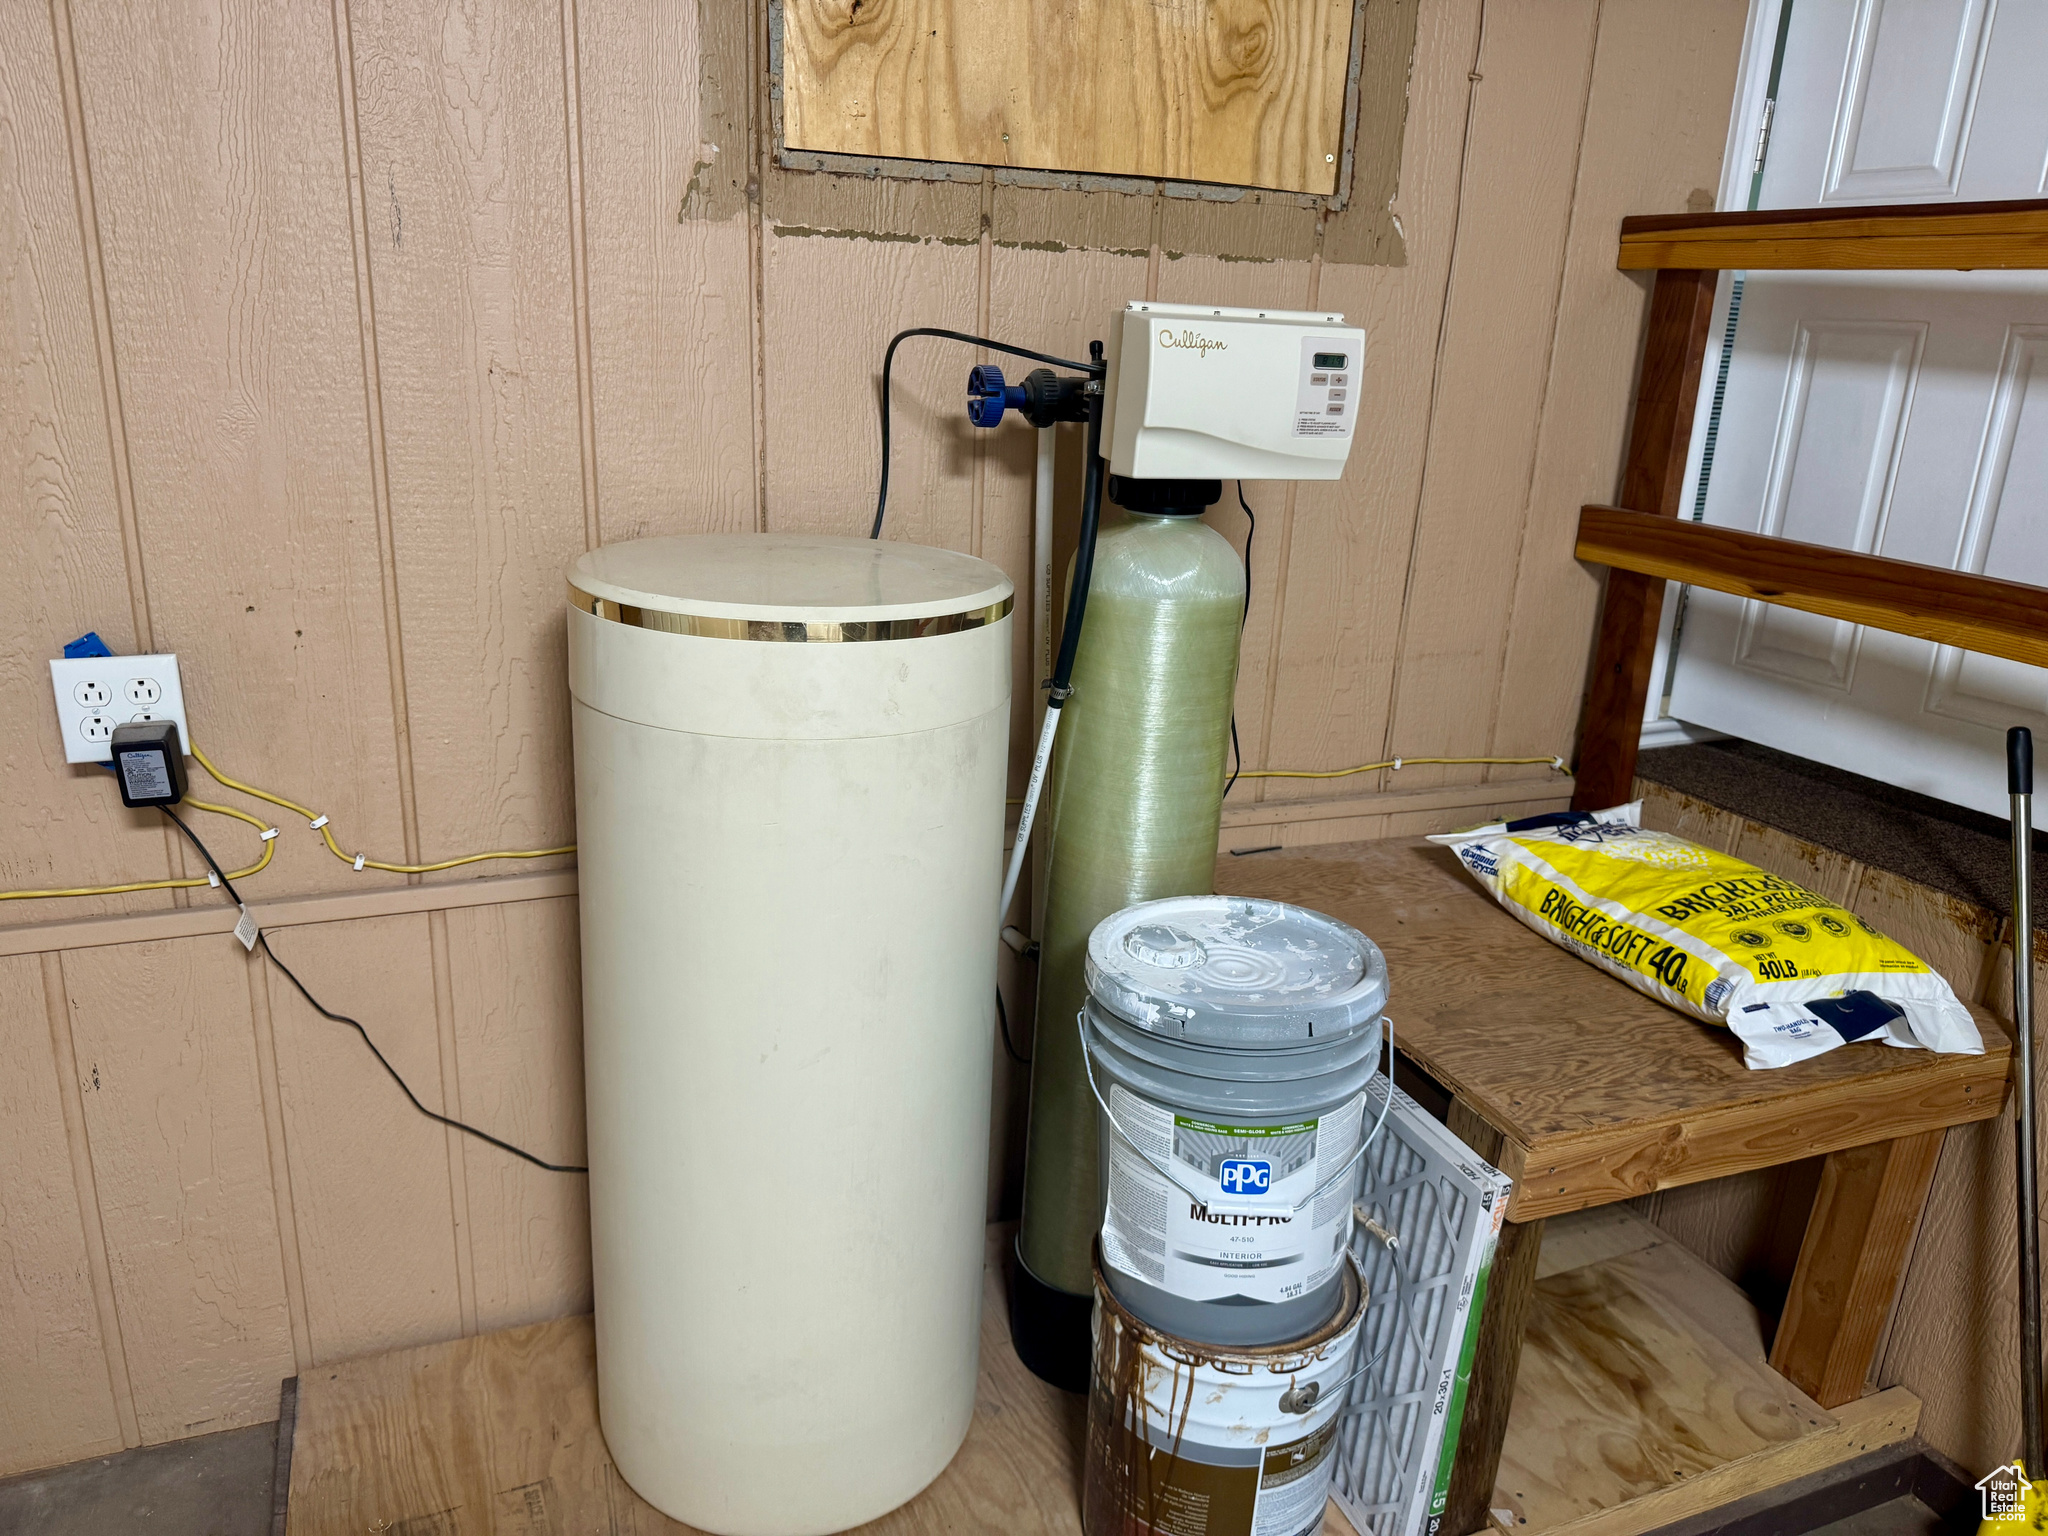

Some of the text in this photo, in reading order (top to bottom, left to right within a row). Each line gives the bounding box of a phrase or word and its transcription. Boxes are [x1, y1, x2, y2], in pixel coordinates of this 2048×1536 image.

[1158, 329, 1228, 358] Culligan
[1718, 900, 1761, 918] SALT
[1752, 905, 1789, 919] WATER
[1223, 1164, 1268, 1192] PPG
[1220, 1252, 1262, 1260] INTERIOR
[1432, 1498, 1446, 1508] 5
